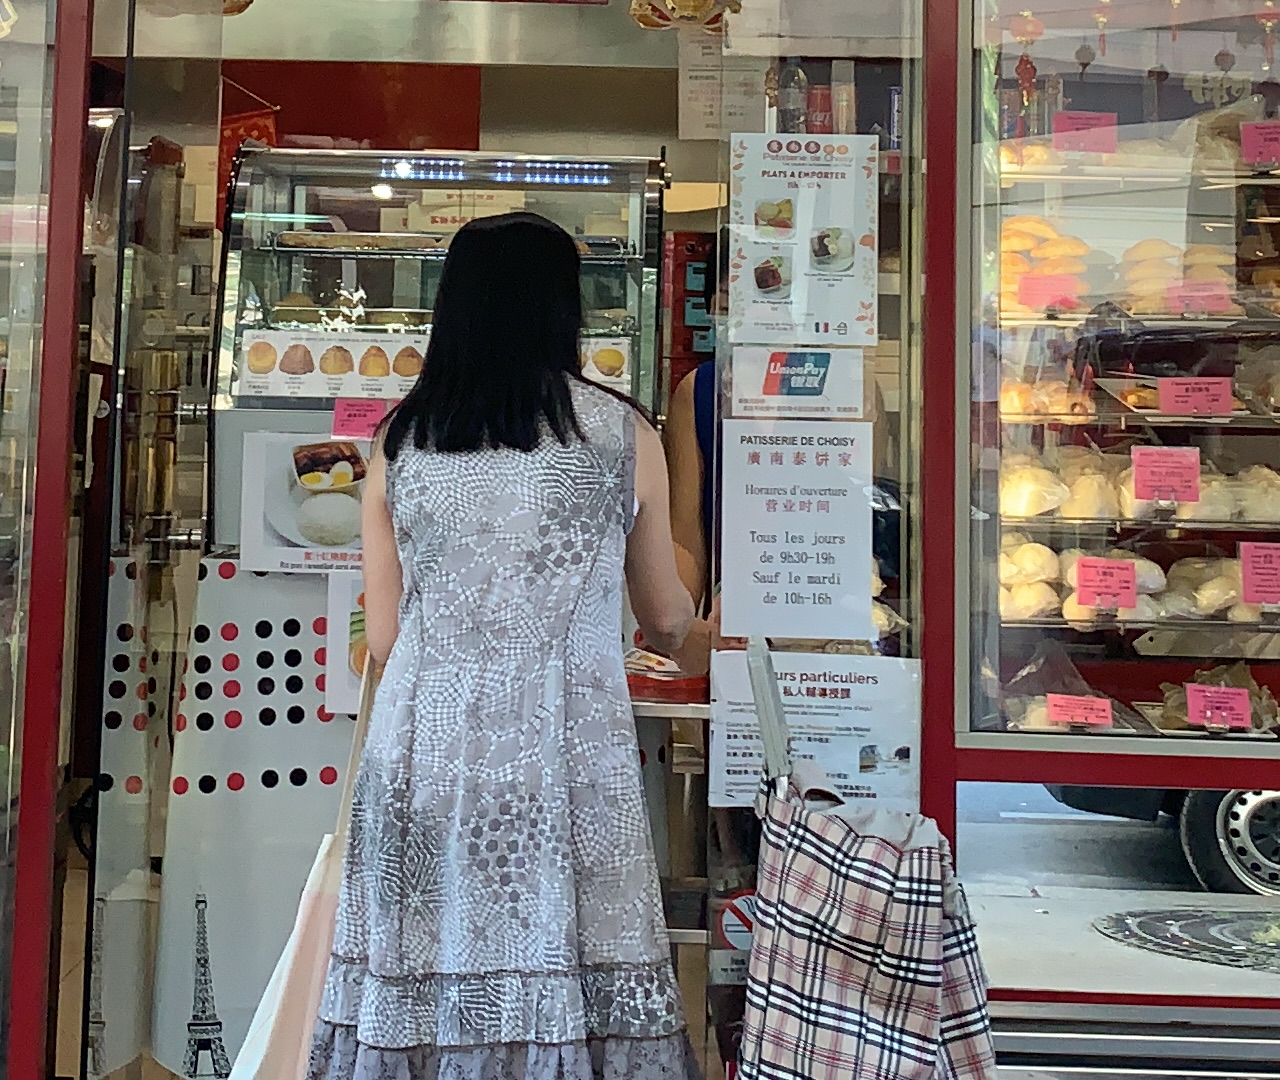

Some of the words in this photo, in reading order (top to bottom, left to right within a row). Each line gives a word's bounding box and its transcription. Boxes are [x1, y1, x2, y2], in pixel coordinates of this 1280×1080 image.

[761, 170, 787, 179] PLATS
[798, 170, 847, 180] EMPORTER
[740, 435, 797, 446] PATISSERIE
[800, 436, 814, 446] DE
[817, 436, 855, 447] CHOISY
[745, 484, 787, 496] Horaires
[789, 484, 848, 497] d'ouverture
[749, 530, 778, 544] Tous
[785, 531, 805, 544] les
[812, 532, 846, 546] jours
[759, 550, 774, 563] de
[780, 551, 836, 565] 9h30-19h
[752, 570, 781, 584] Sauf
[788, 571, 801, 584] le
[807, 572, 841, 585] mardi
[763, 591, 777, 604] de
[784, 592, 832, 605] 10h-16h
[799, 670, 879, 685] particuliers
